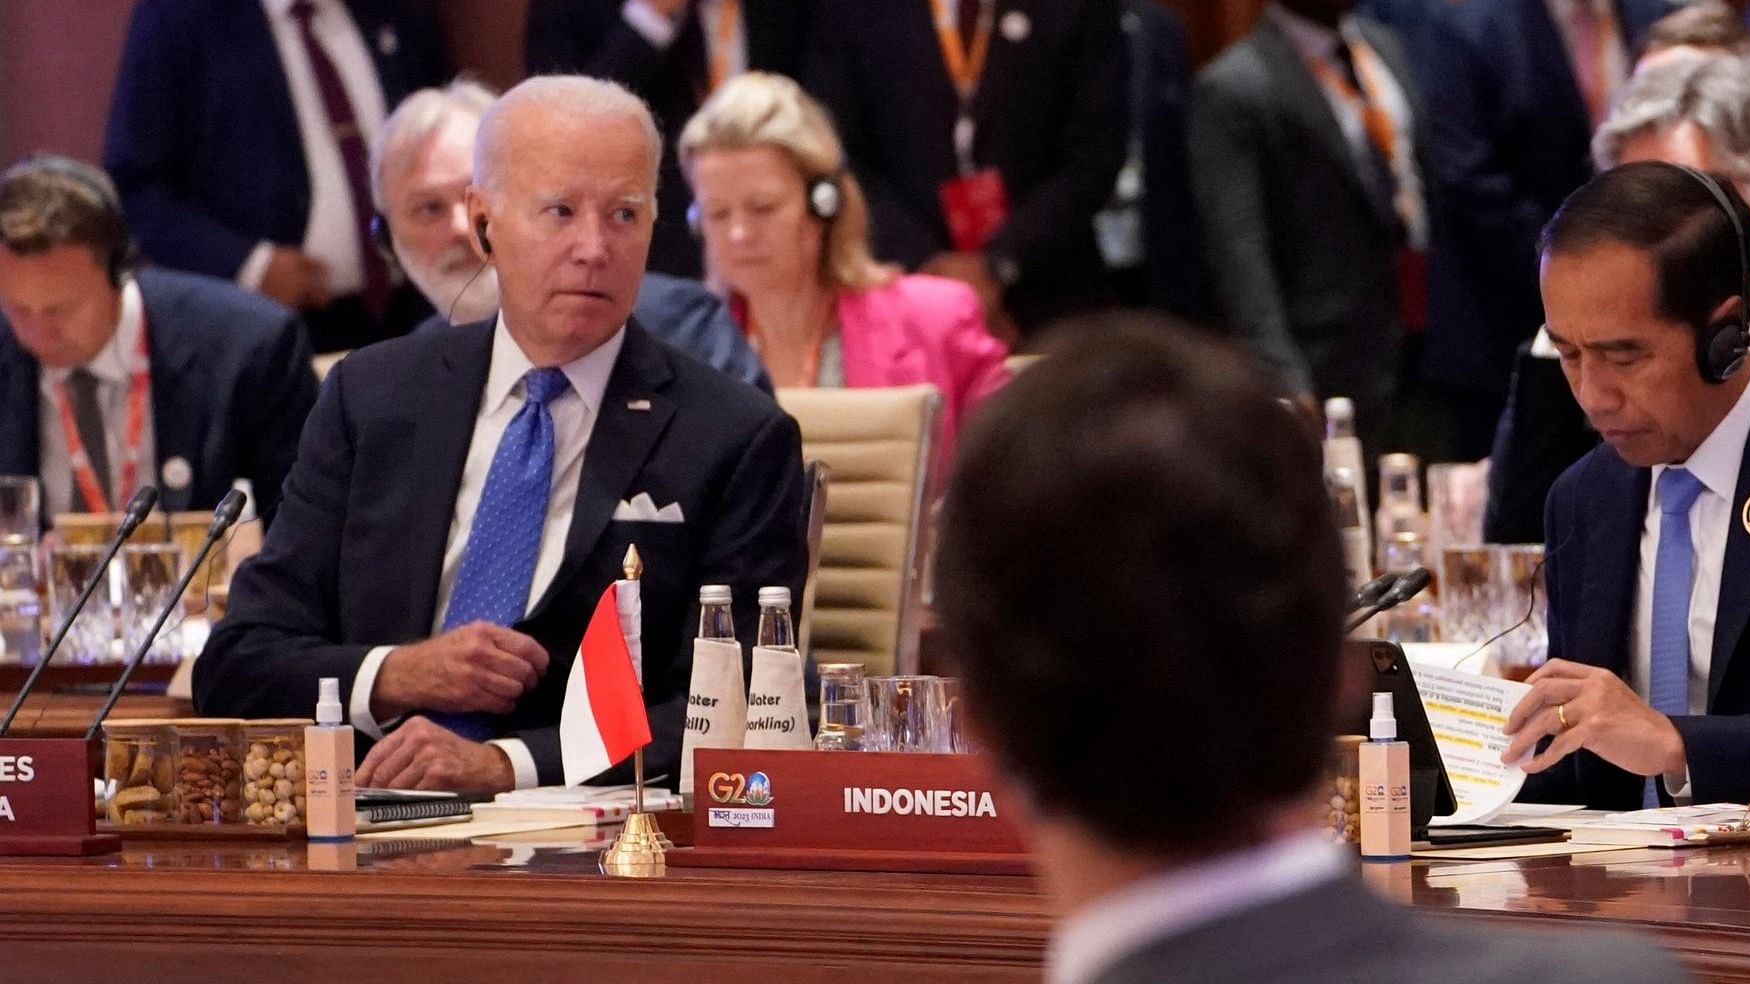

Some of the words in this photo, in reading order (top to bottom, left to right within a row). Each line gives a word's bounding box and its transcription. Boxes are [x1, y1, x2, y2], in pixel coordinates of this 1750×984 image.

[690, 694, 718, 707] ater
[0, 755, 35, 782] ES
[843, 787, 998, 818] INDONESIA
[751, 812, 771, 820] INDIA
